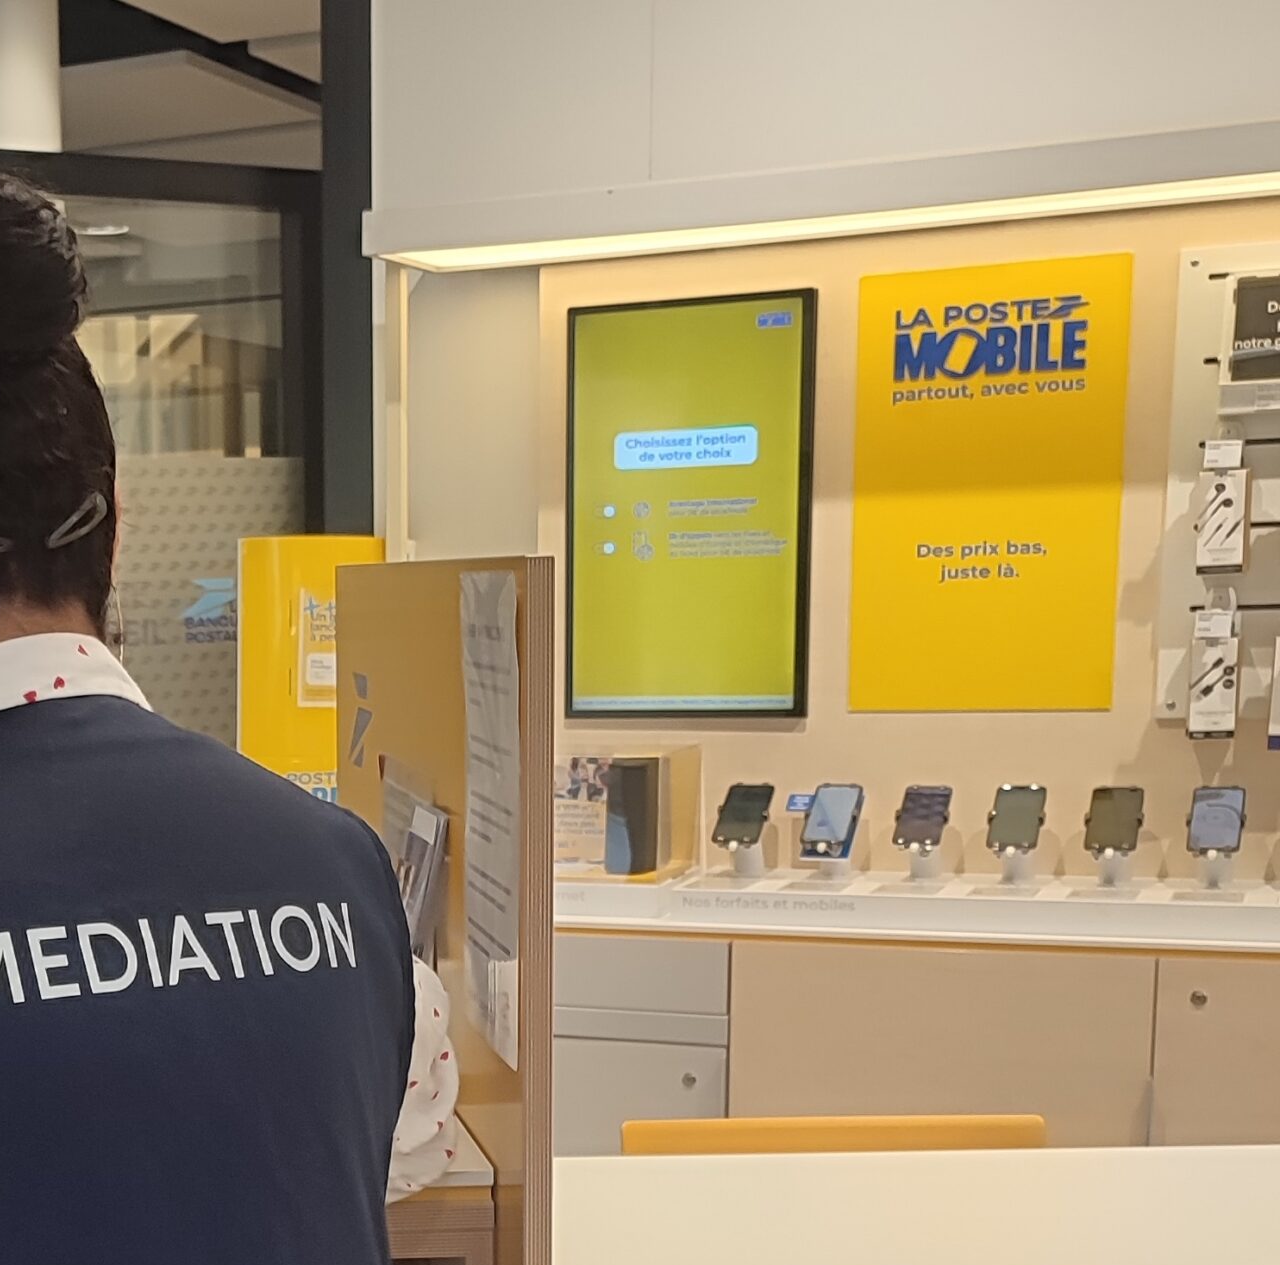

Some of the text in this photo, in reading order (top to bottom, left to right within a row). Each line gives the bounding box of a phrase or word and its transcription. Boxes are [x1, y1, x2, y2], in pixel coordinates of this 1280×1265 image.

[895, 299, 1050, 330] LA POSTE
[894, 321, 1087, 381] MOBILE
[1235, 338, 1272, 350] notre
[892, 376, 1086, 406] partout, avec vous
[625, 433, 746, 450] Choisissez l'option
[639, 447, 731, 463] de votre choix
[916, 539, 1048, 563] Des prix bas,
[938, 562, 1021, 583] juste là.
[286, 772, 336, 786] POST
[681, 896, 856, 912] Nos forfaits et mobiles
